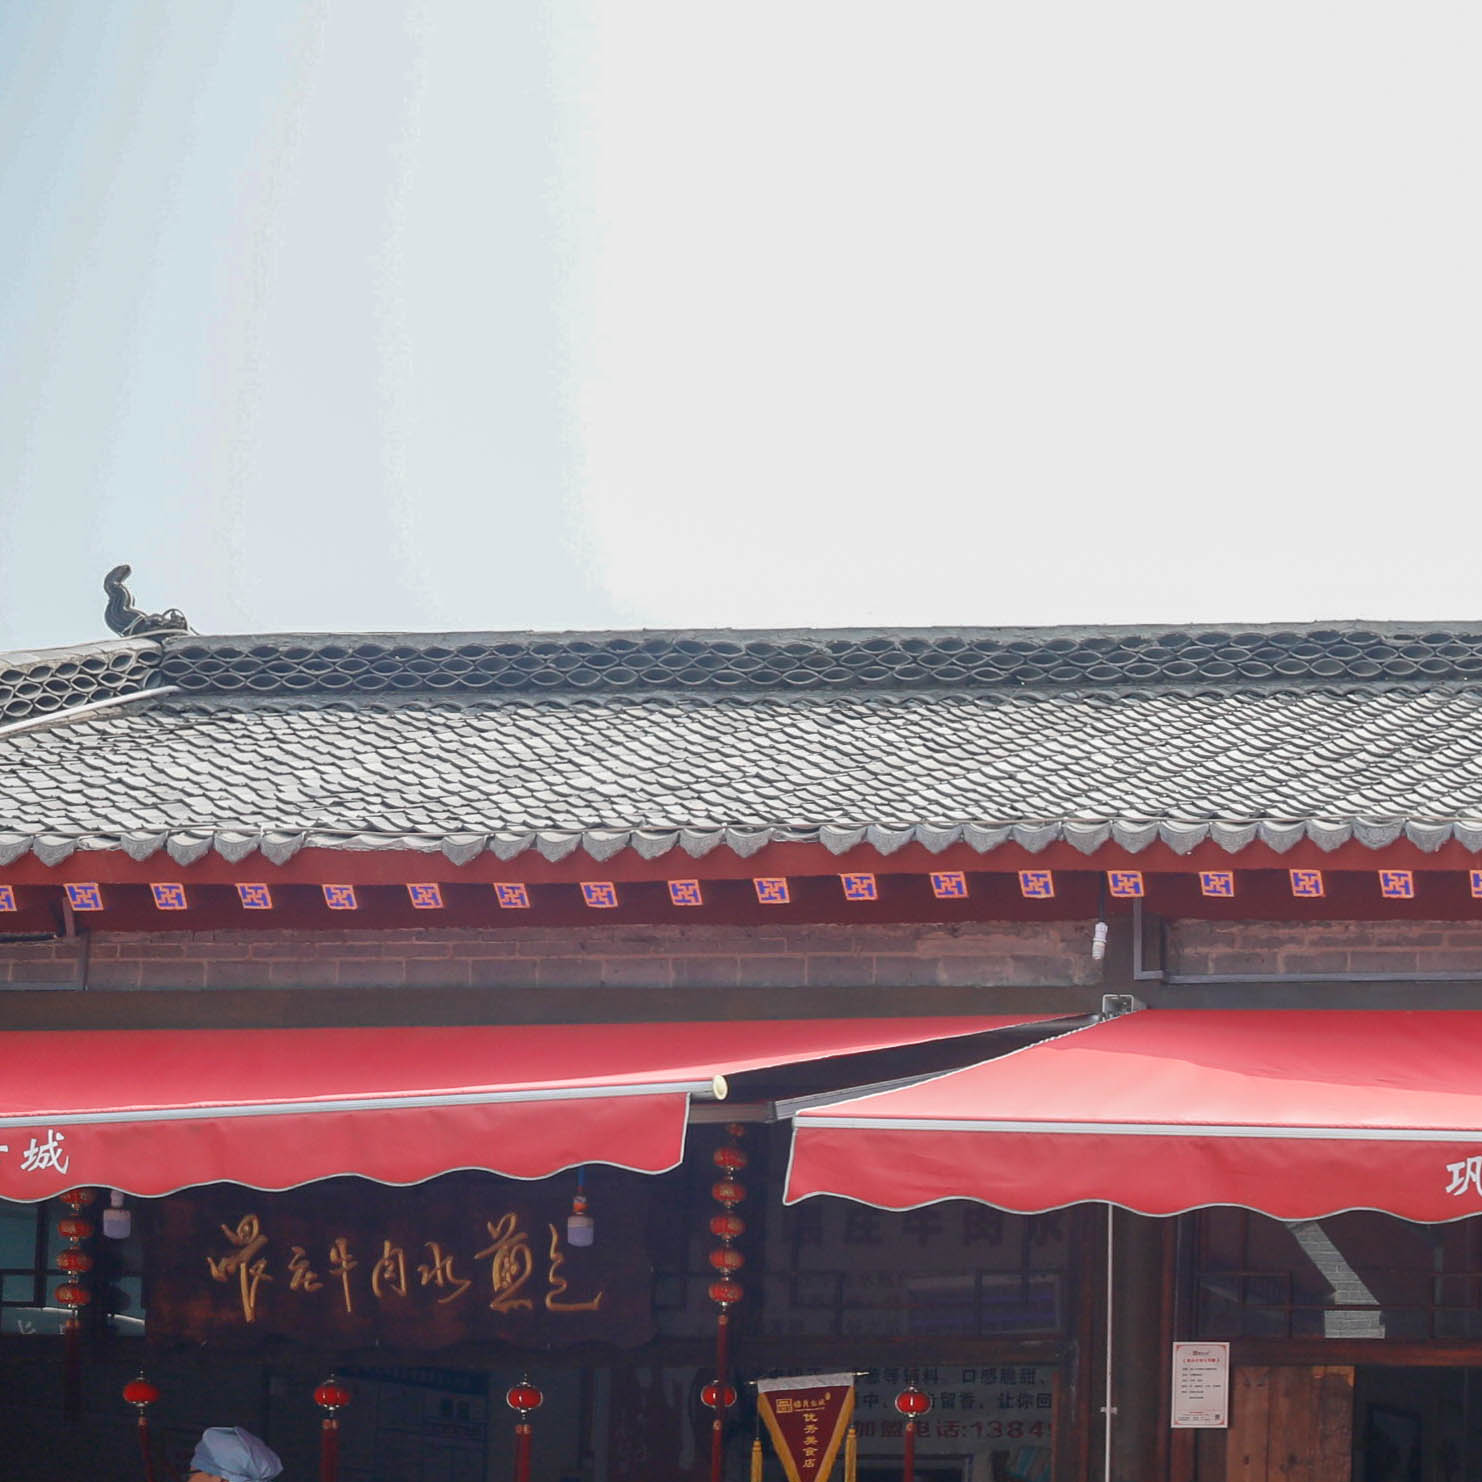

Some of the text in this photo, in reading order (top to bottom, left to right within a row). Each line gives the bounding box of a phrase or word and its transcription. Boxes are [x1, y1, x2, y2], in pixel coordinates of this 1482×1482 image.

[0, 1130, 69, 1174] 城
[802, 1413, 819, 1468] 优秀美食店
[857, 1420, 1052, 1439] 加盟电话:1384
